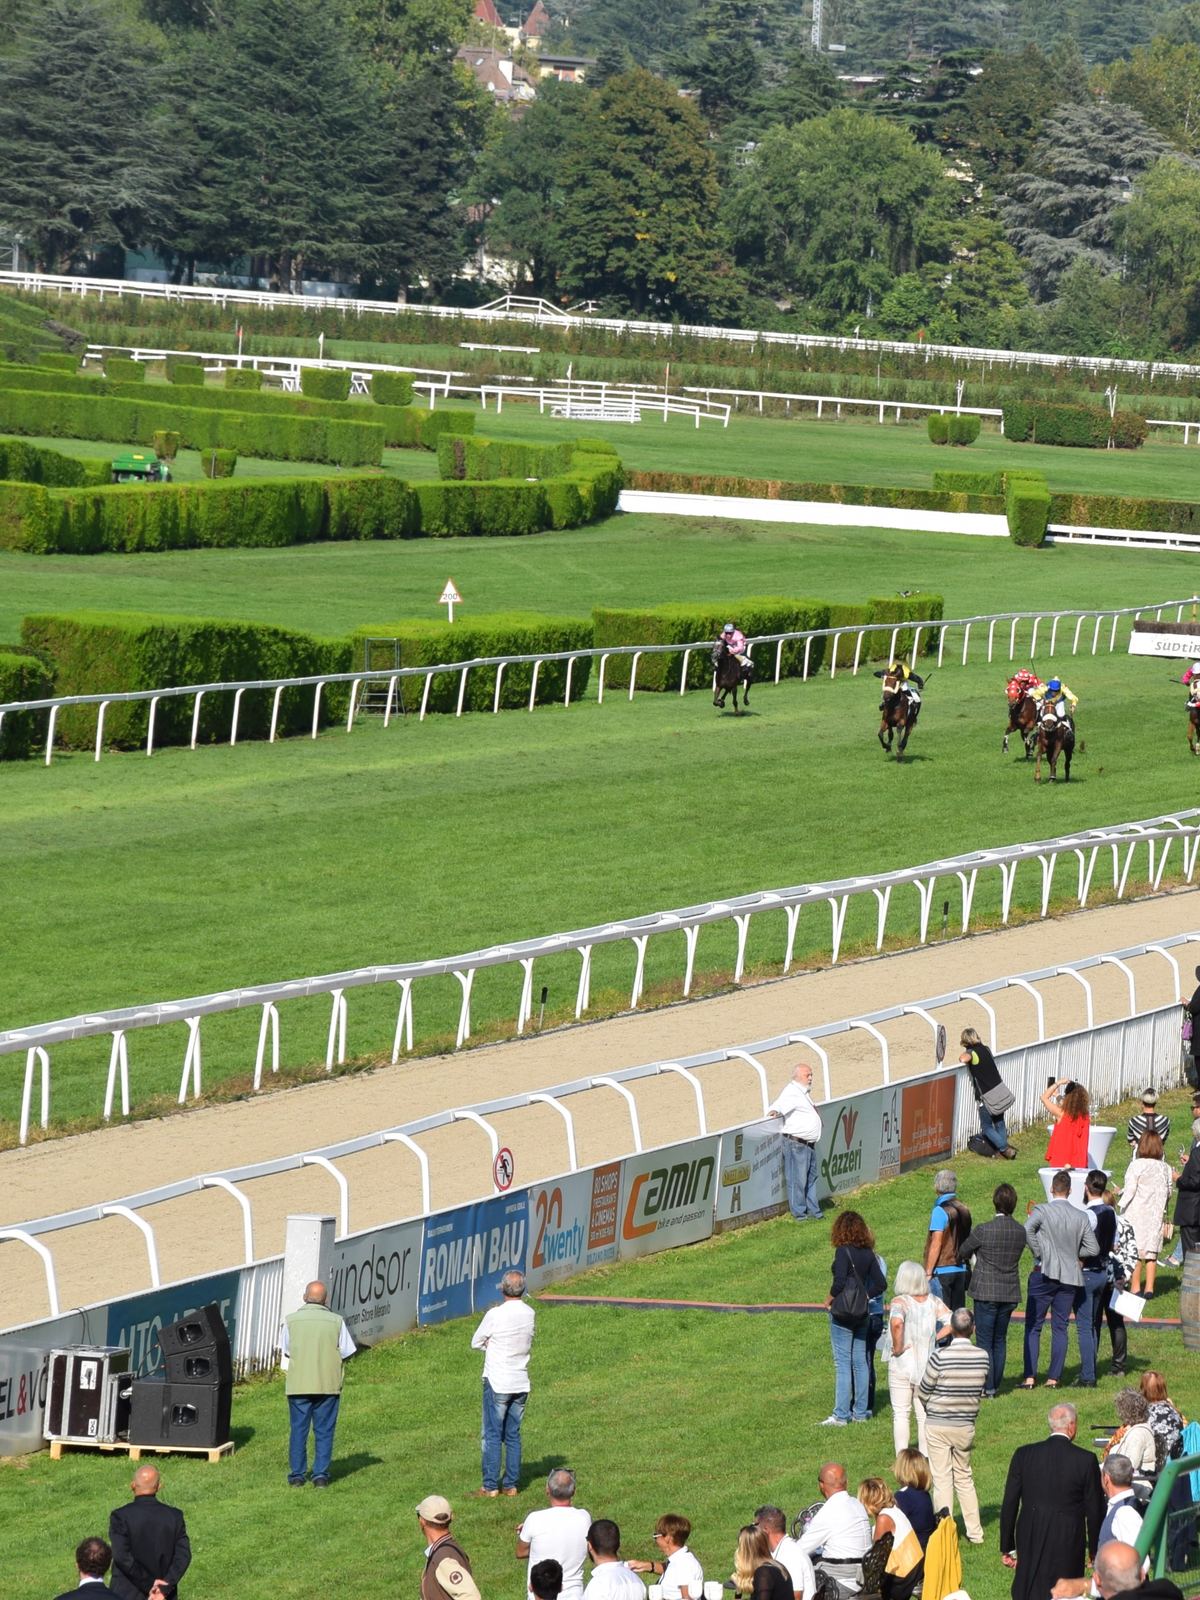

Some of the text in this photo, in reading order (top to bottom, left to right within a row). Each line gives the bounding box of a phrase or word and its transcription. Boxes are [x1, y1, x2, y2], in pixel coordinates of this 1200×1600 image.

[601, 1172, 618, 1193] SHOPS
[595, 1206, 615, 1226] CINEMAS
[657, 1209, 705, 1230] bike and passion
[542, 1217, 585, 1266] twenty
[422, 1219, 525, 1295] ROMAN BAU
[361, 1308, 374, 1323] Store
